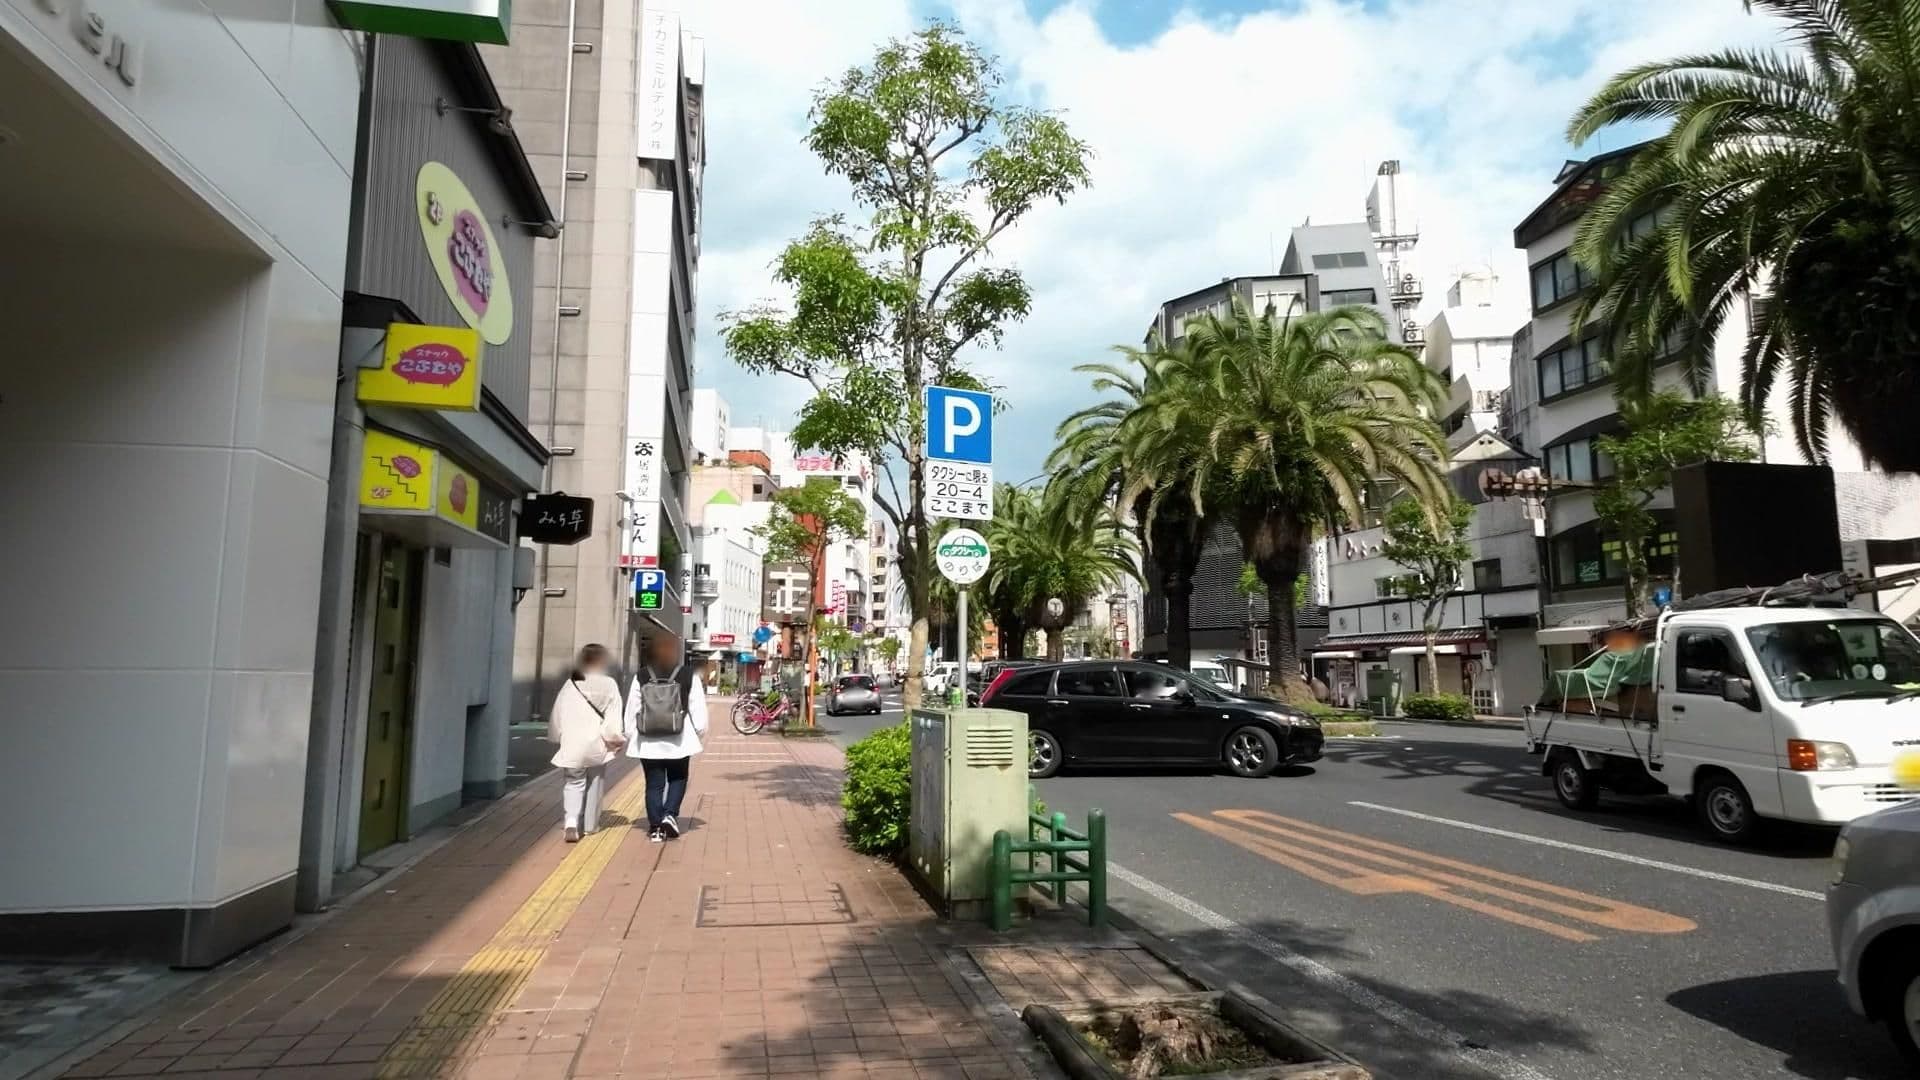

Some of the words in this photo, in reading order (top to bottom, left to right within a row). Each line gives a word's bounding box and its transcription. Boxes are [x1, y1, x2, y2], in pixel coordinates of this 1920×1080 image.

[415, 348, 449, 358] スナック
[944, 395, 981, 453] P
[931, 465, 989, 484] タクシーに限る
[931, 499, 988, 515] ここまで
[538, 509, 585, 532] みち草
[641, 572, 658, 590] P
[640, 592, 658, 608] 空
